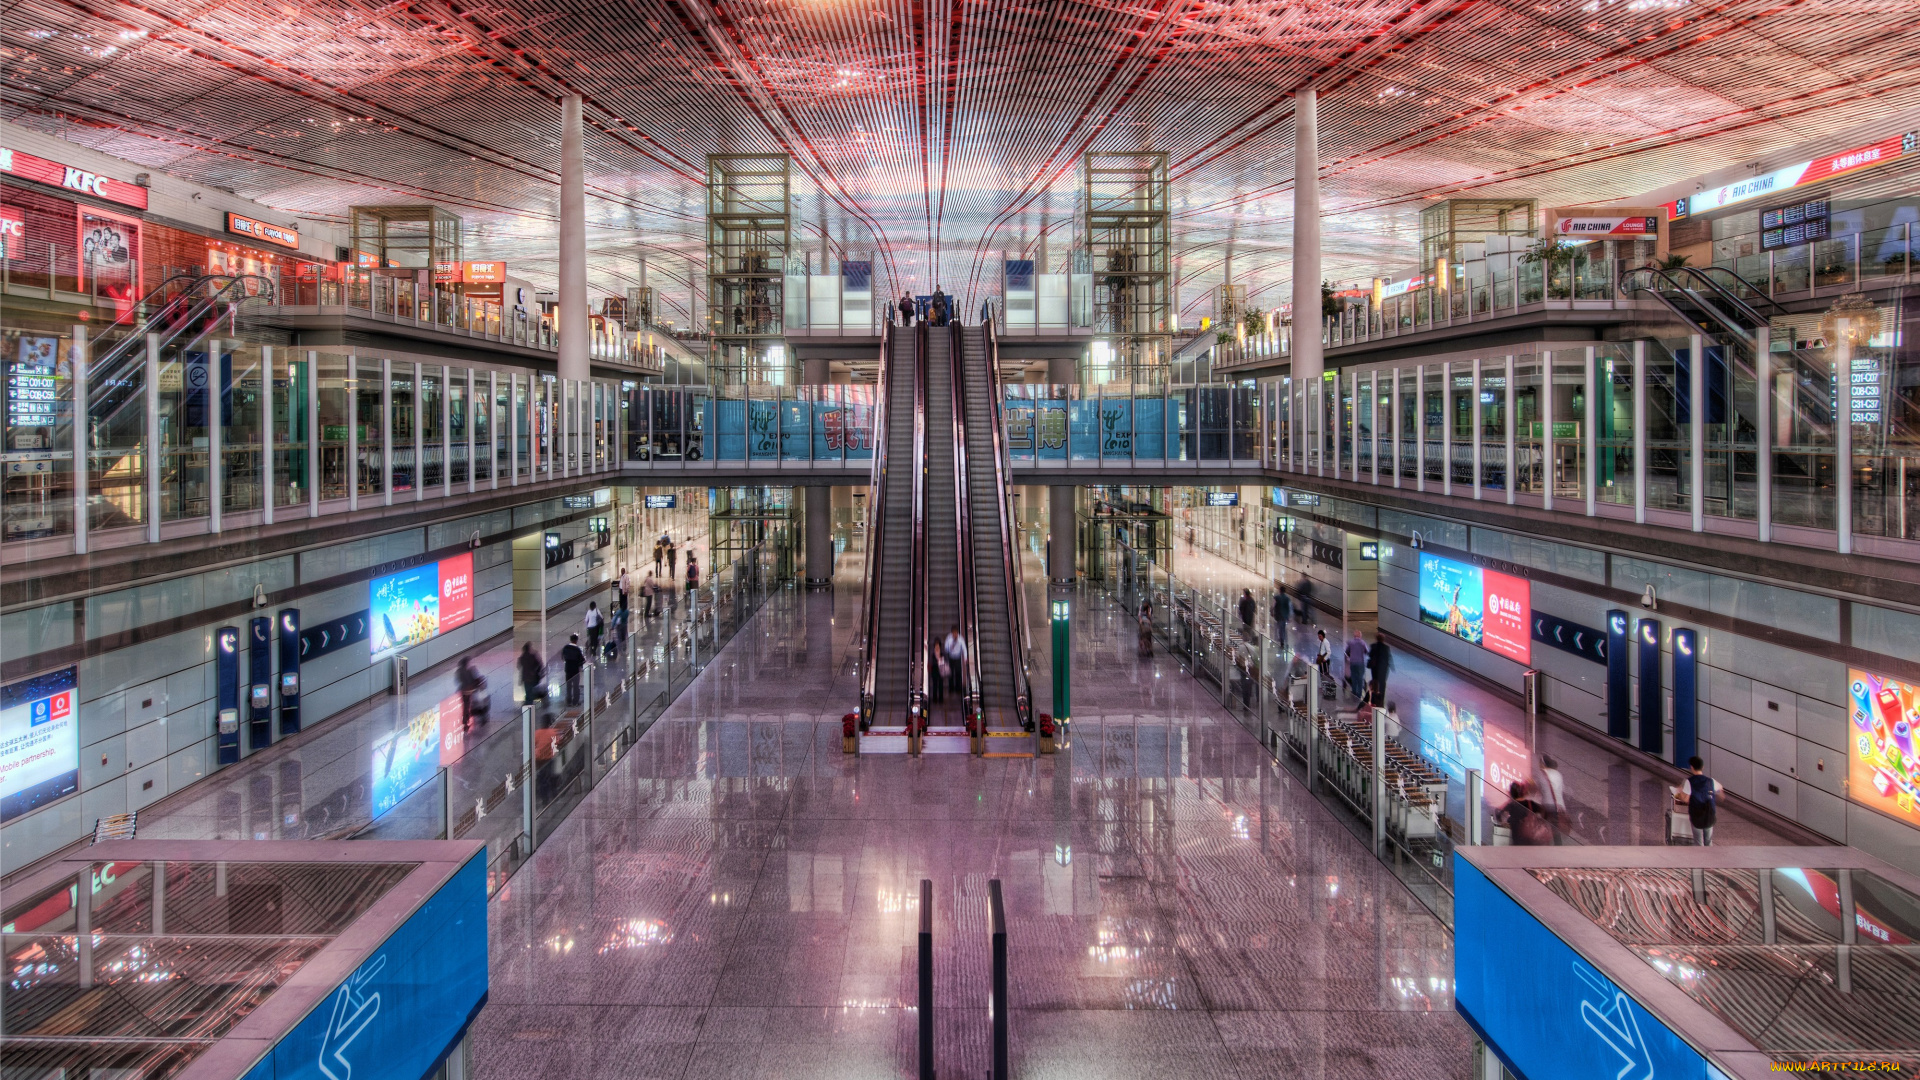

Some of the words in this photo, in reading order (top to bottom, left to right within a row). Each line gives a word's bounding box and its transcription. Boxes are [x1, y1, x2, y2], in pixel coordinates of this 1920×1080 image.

[1831, 148, 1881, 172] 头等舱休息室
[62, 166, 109, 197] KFC
[1732, 185, 1746, 198] AIR
[1748, 177, 1773, 194] CHINA
[0, 218, 24, 236] FC
[1573, 223, 1586, 231] AIR
[1588, 223, 1611, 231] CHINA
[1851, 373, 1879, 382] C01-C07
[1851, 386, 1879, 396] C08-C30
[1851, 399, 1879, 409] C31-C37
[1851, 412, 1879, 422] C51-C58
[1104, 432, 1129, 449] 2010
[1499, 597, 1521, 615] 中国银行
